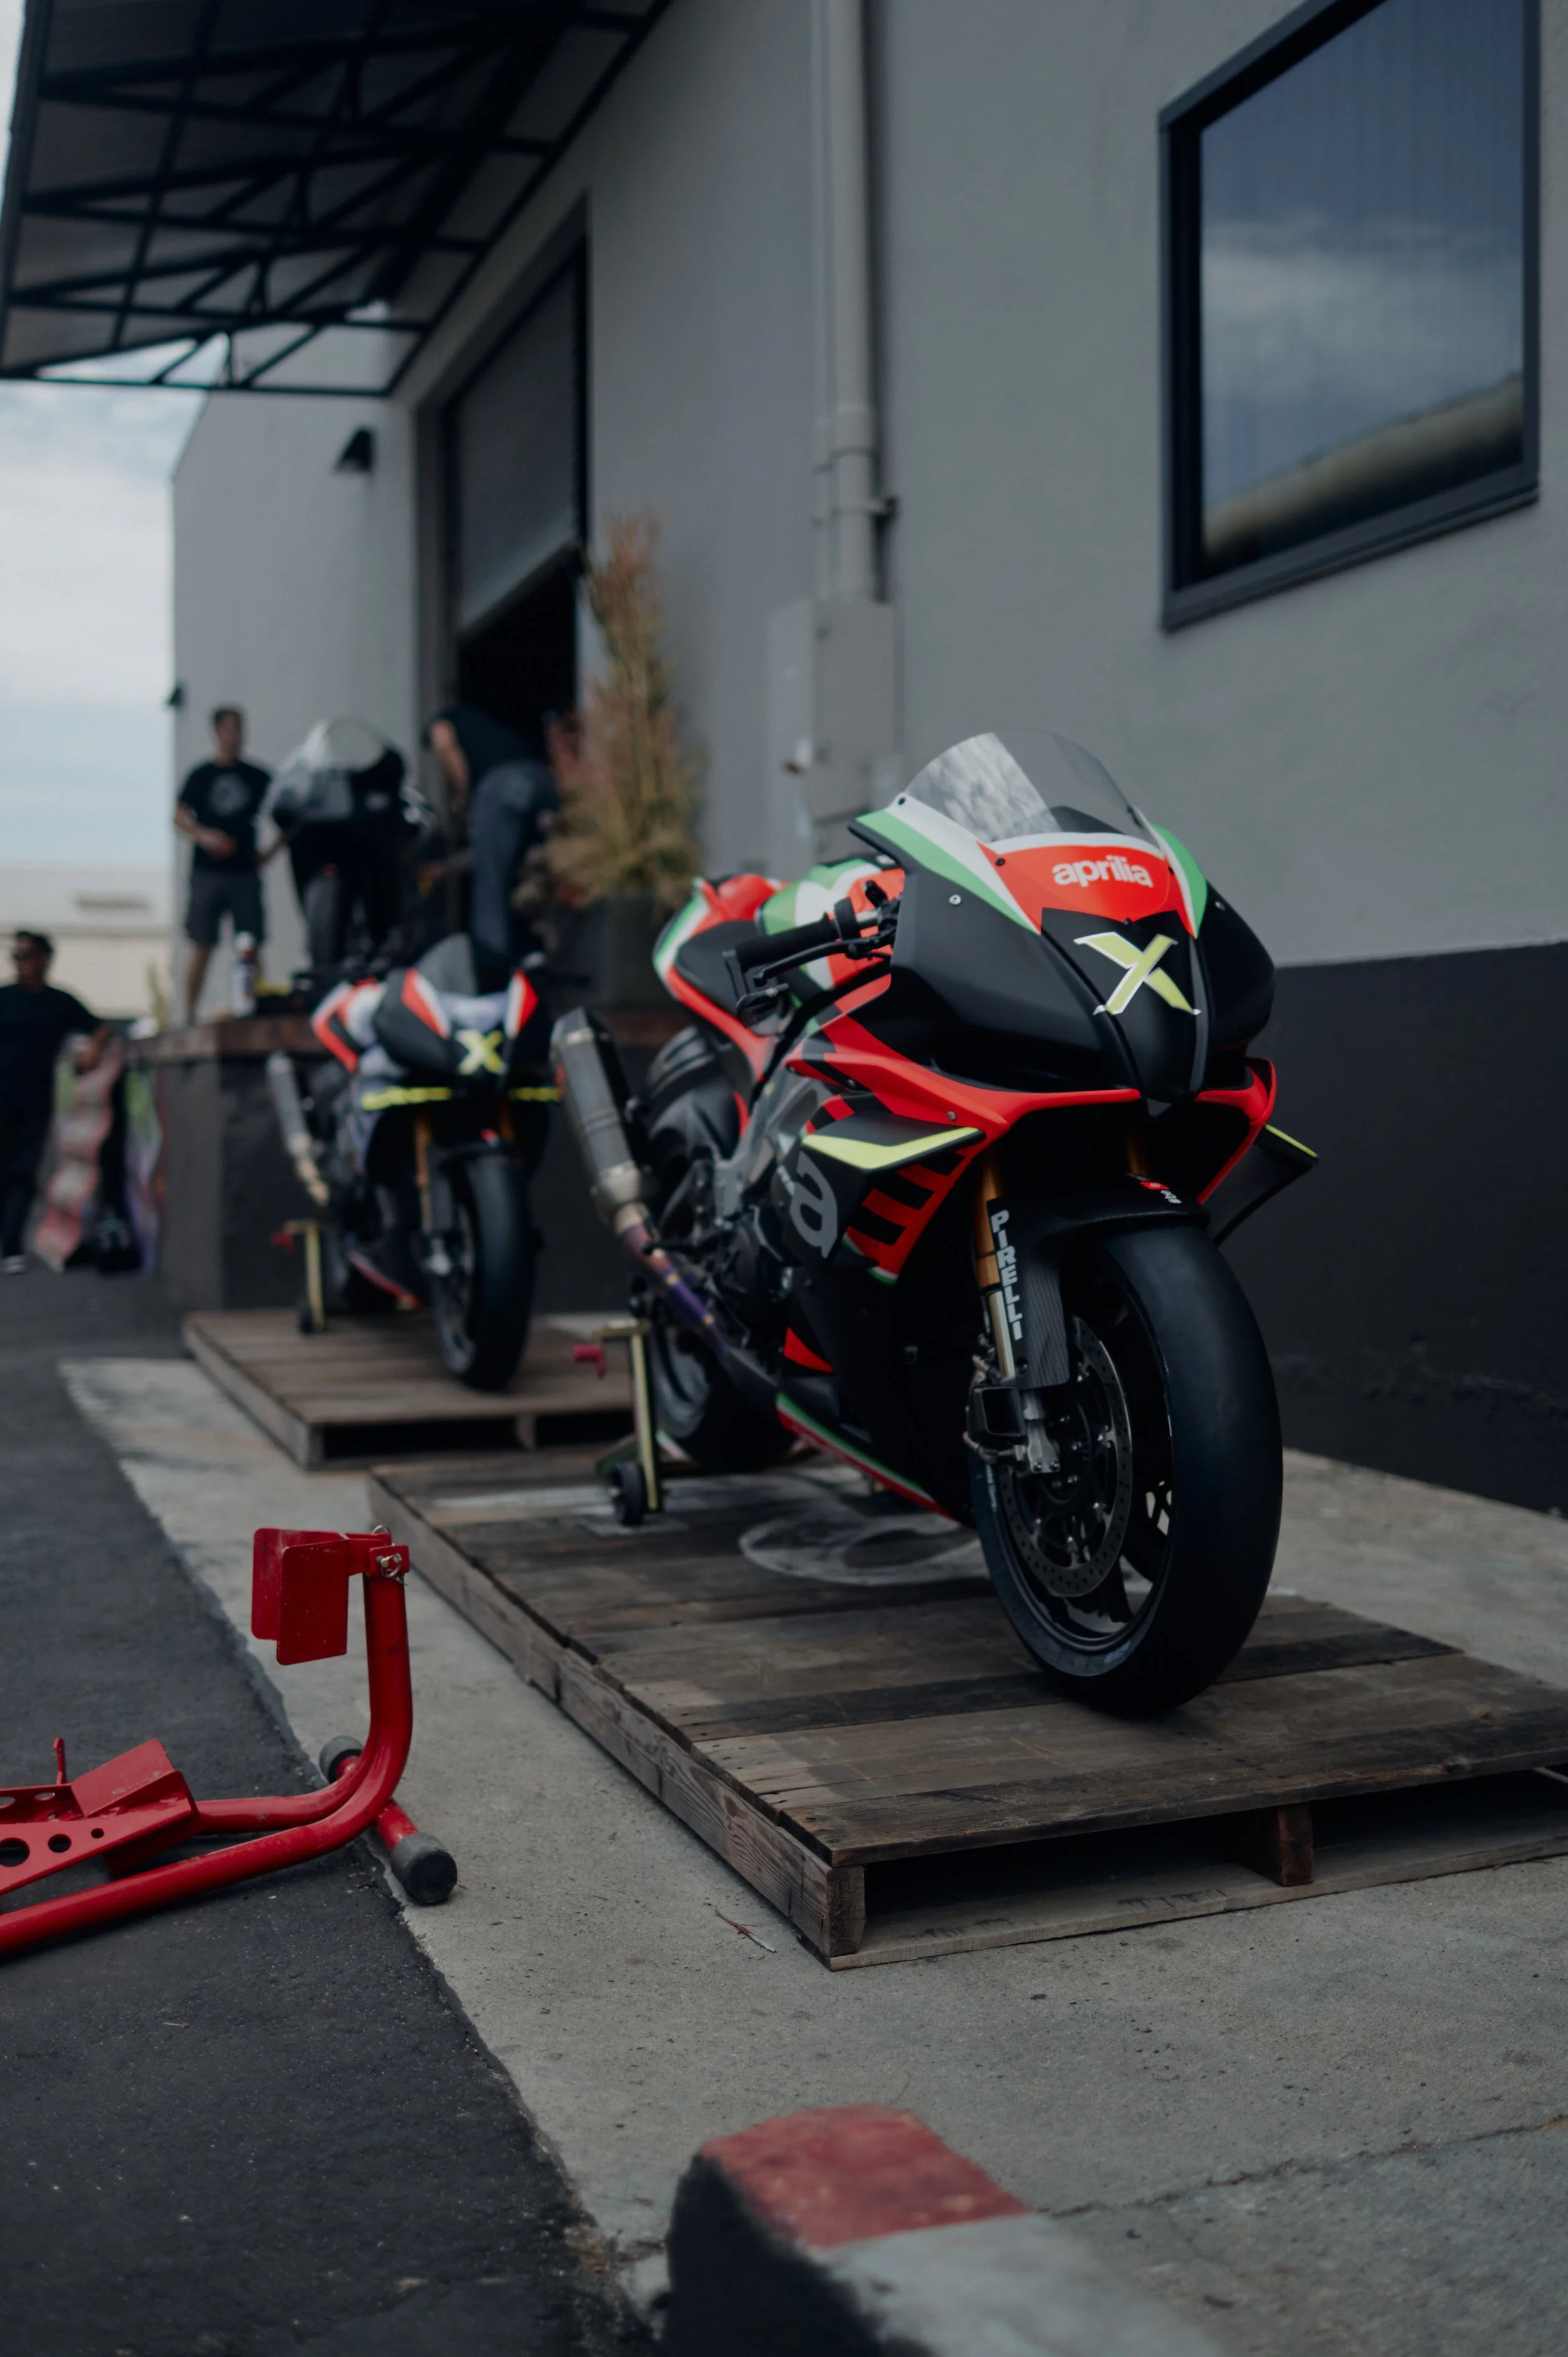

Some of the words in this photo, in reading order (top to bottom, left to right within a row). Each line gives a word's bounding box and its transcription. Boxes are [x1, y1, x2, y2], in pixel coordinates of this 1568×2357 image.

[1052, 854, 1154, 888] aprilia
[1073, 931, 1202, 1015] X
[455, 1029, 507, 1076] X
[991, 1209, 1023, 1341] PIRELLI
